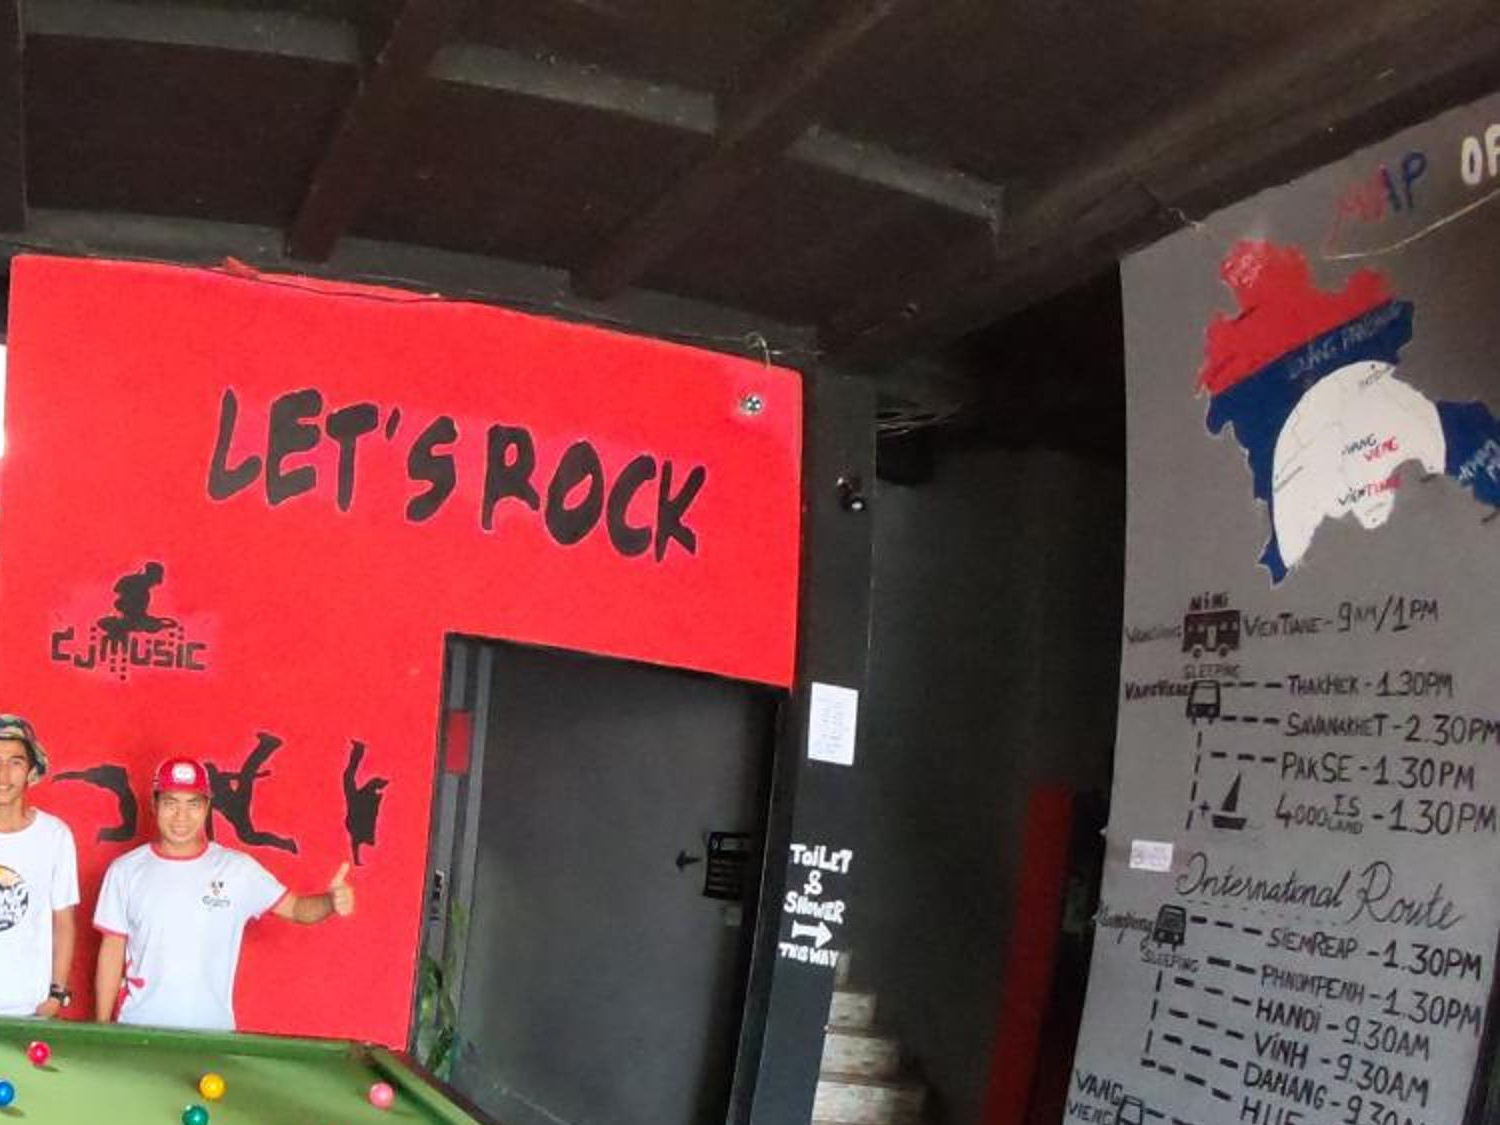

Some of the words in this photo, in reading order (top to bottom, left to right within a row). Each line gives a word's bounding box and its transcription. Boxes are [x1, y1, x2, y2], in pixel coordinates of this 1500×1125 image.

[206, 387, 458, 523] LET'S
[480, 423, 706, 562] ROCK
[1346, 860, 1468, 930] Route
[1243, 1060, 1328, 1111] DANANG
